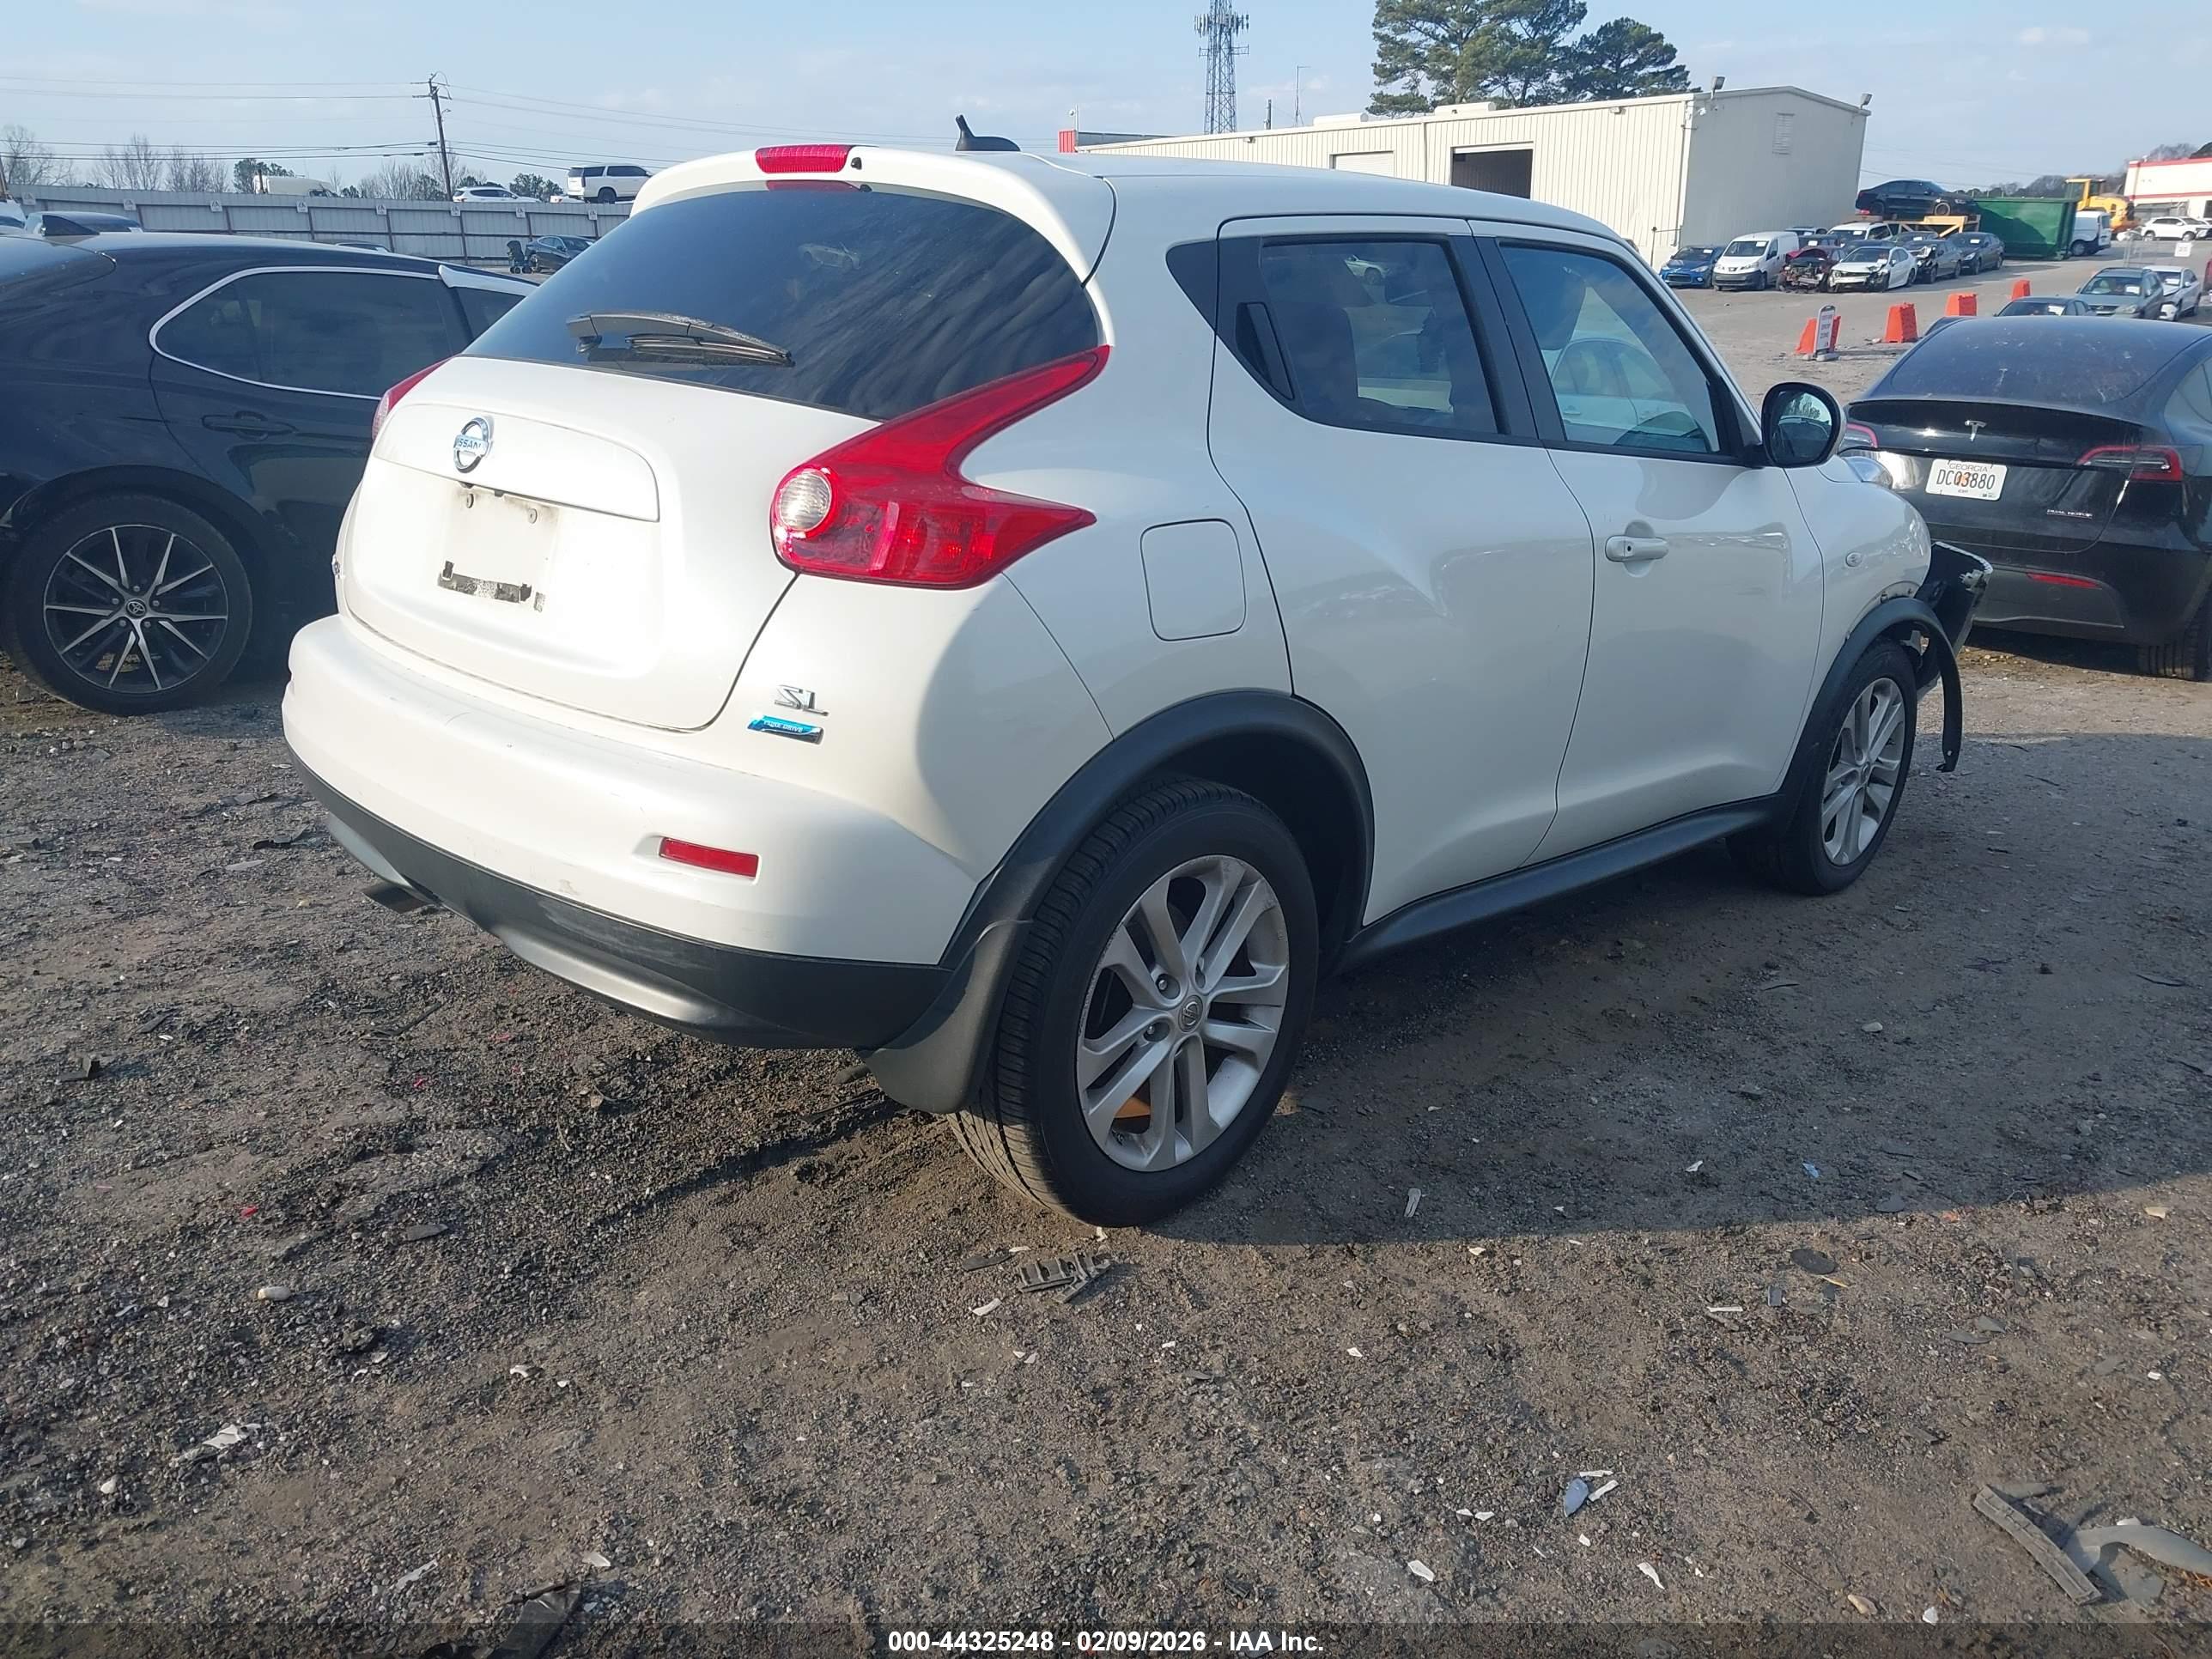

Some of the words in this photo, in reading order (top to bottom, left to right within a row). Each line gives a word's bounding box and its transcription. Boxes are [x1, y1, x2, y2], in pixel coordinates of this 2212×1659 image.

[1948, 463, 1989, 473] GEORGIA
[775, 684, 830, 717] SL
[782, 723, 804, 733] DRIVE
